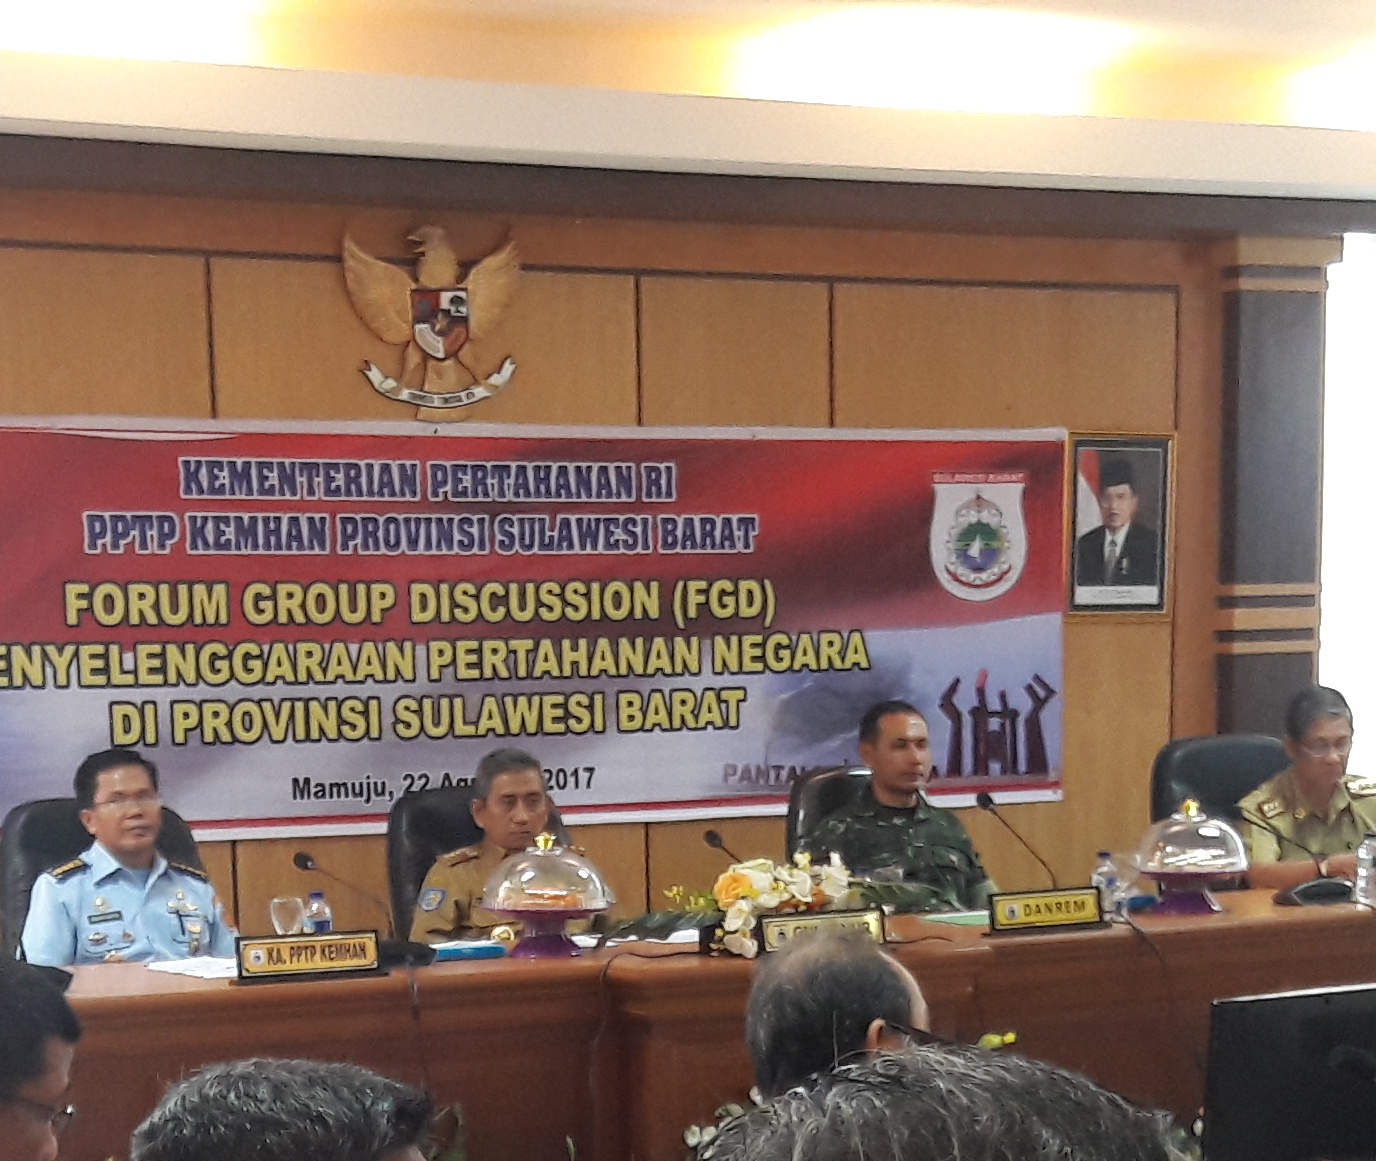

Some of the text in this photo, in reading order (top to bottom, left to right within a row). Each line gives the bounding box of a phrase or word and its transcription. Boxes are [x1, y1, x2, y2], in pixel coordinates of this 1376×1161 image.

[180, 458, 675, 501] KEMENTERIAN PERTAHANAN RI
[83, 511, 758, 554] PPTP KEMHAN PROVINSI SULAWESI BARAT
[64, 577, 776, 629] FORUM GROUP DISCUSSION (FGD)
[428, 635, 702, 681] PERTAHANAN
[712, 629, 871, 673] NEGARA
[111, 686, 746, 746] DI PROVINSI SULAWESI BARAT
[291, 775, 395, 805] Mamuju,
[542, 766, 596, 791] 2017
[1023, 900, 1086, 917] DANREM
[289, 944, 317, 965] PPTP
